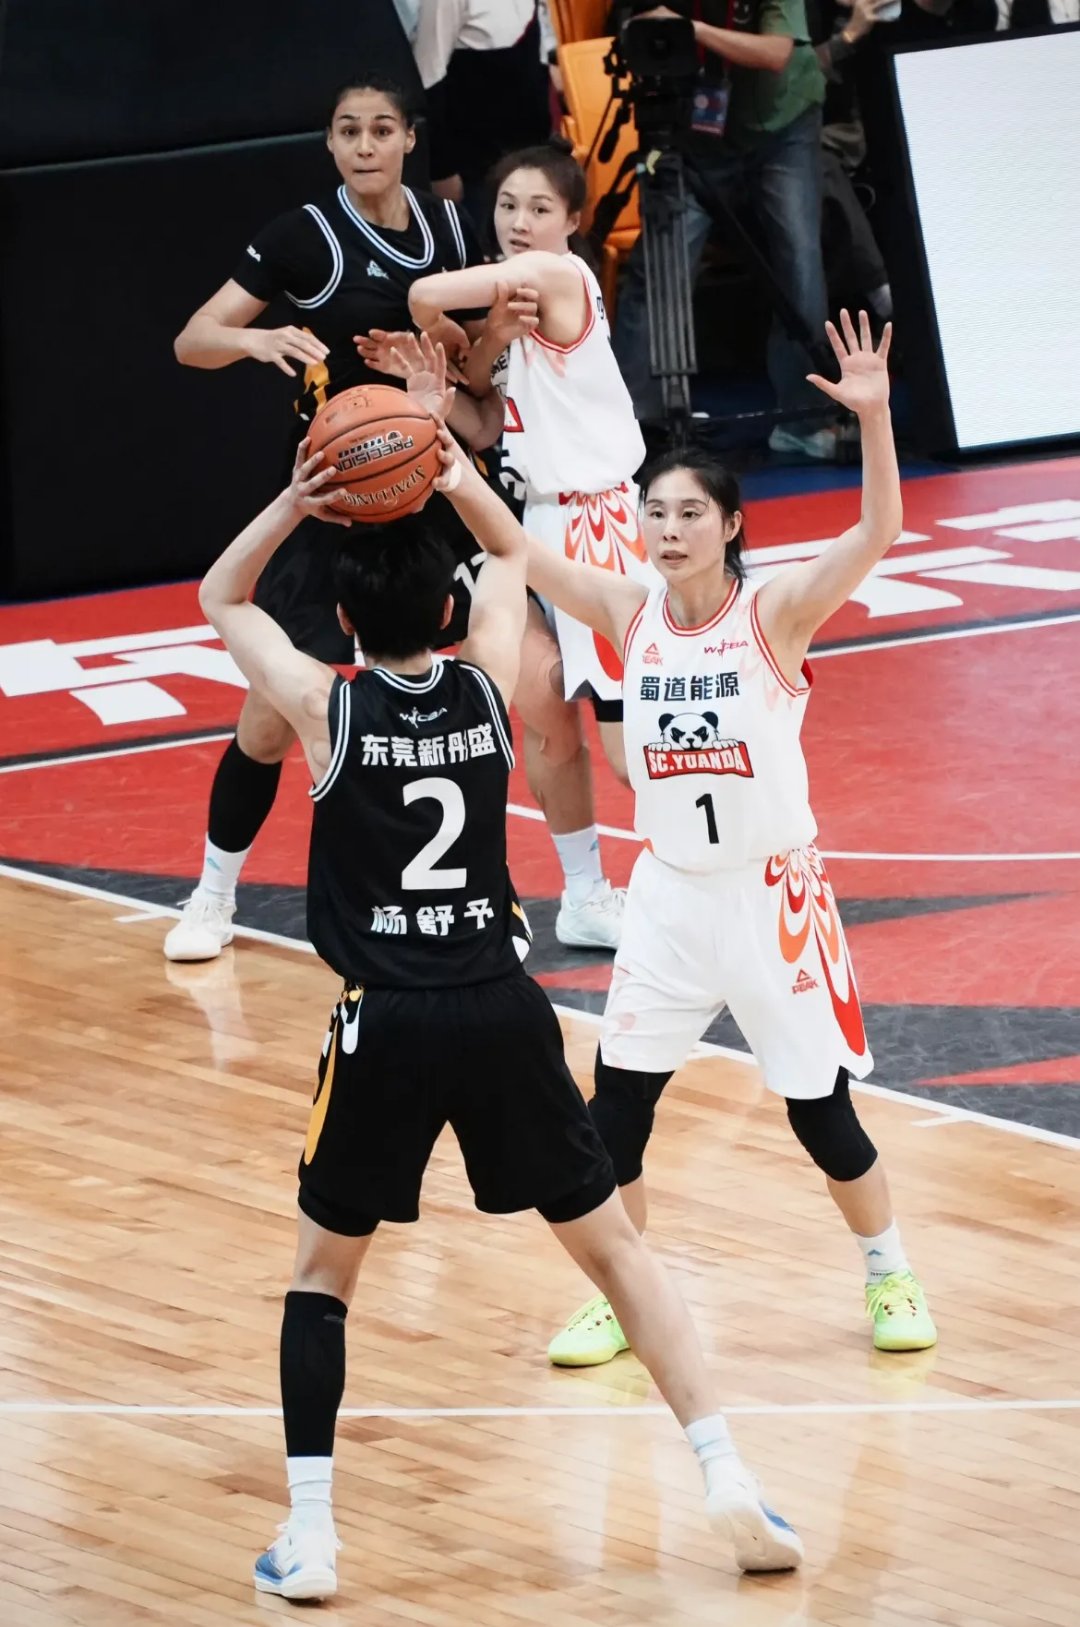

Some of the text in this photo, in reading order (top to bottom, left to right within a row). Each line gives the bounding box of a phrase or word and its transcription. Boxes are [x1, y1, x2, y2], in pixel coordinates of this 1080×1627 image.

[333, 436, 414, 473] PRECISION
[343, 464, 426, 507] SPALDING
[640, 671, 740, 702] 蜀道能源
[360, 722, 497, 767] 东莞新彤盛
[648, 747, 748, 774] SC.YUANDA
[401, 776, 467, 890] 2
[695, 793, 720, 844] 1
[370, 898, 495, 936] 杨舒予
